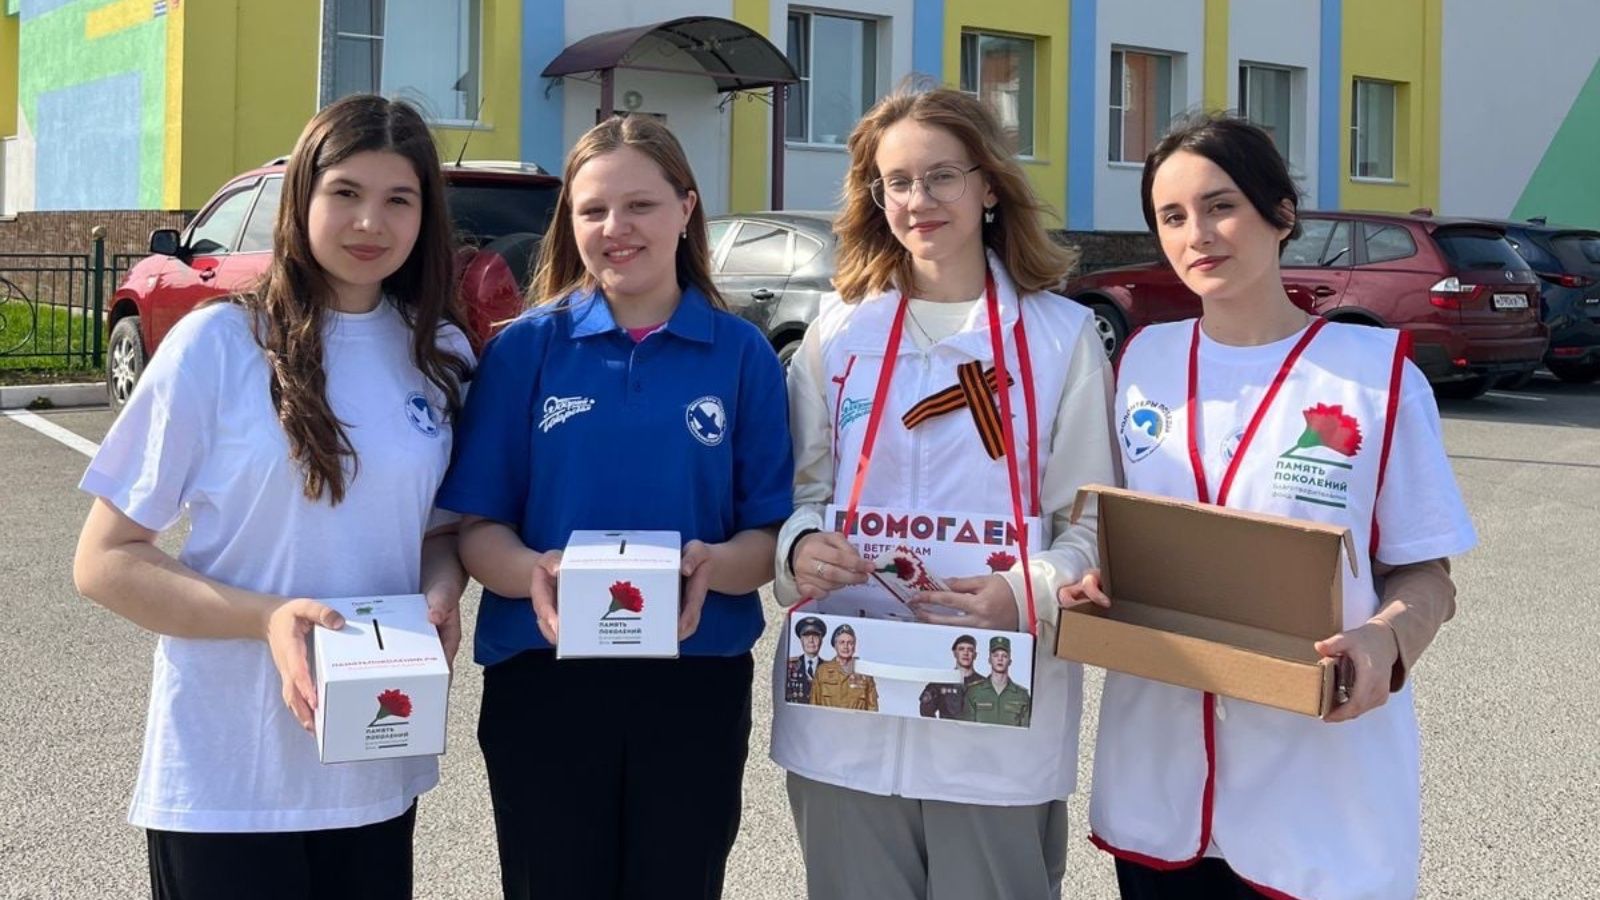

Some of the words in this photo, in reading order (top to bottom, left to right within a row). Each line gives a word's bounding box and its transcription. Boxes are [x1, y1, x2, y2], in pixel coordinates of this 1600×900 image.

[1276, 461, 1326, 475] ПАМЯТЬ
[1274, 472, 1348, 492] ПОКОЛЕНИЙ
[863, 543, 931, 556] ВЕТЕАМ
